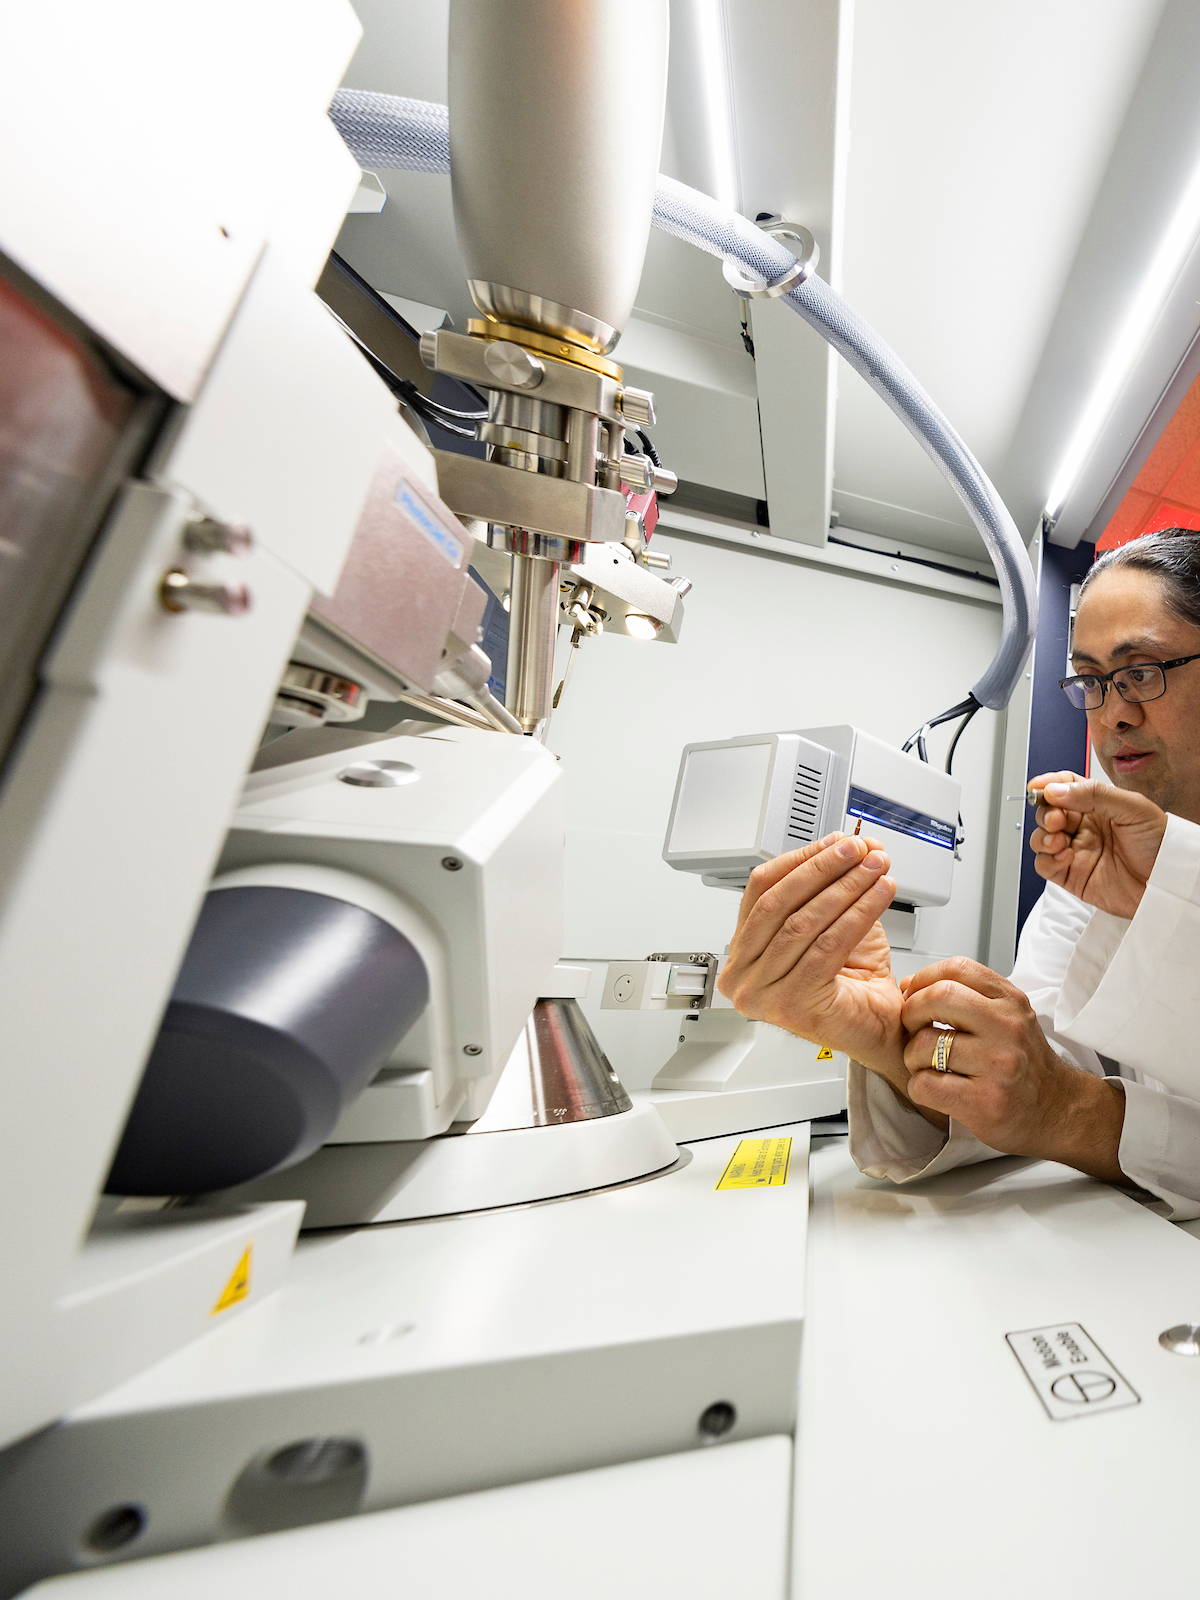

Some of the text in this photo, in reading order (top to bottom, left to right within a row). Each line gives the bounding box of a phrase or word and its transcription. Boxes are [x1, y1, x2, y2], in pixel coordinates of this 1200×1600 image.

[930, 819, 952, 833] Rigaku
[1032, 1335, 1061, 1369] Motion
[1057, 1331, 1088, 1364] Enable
